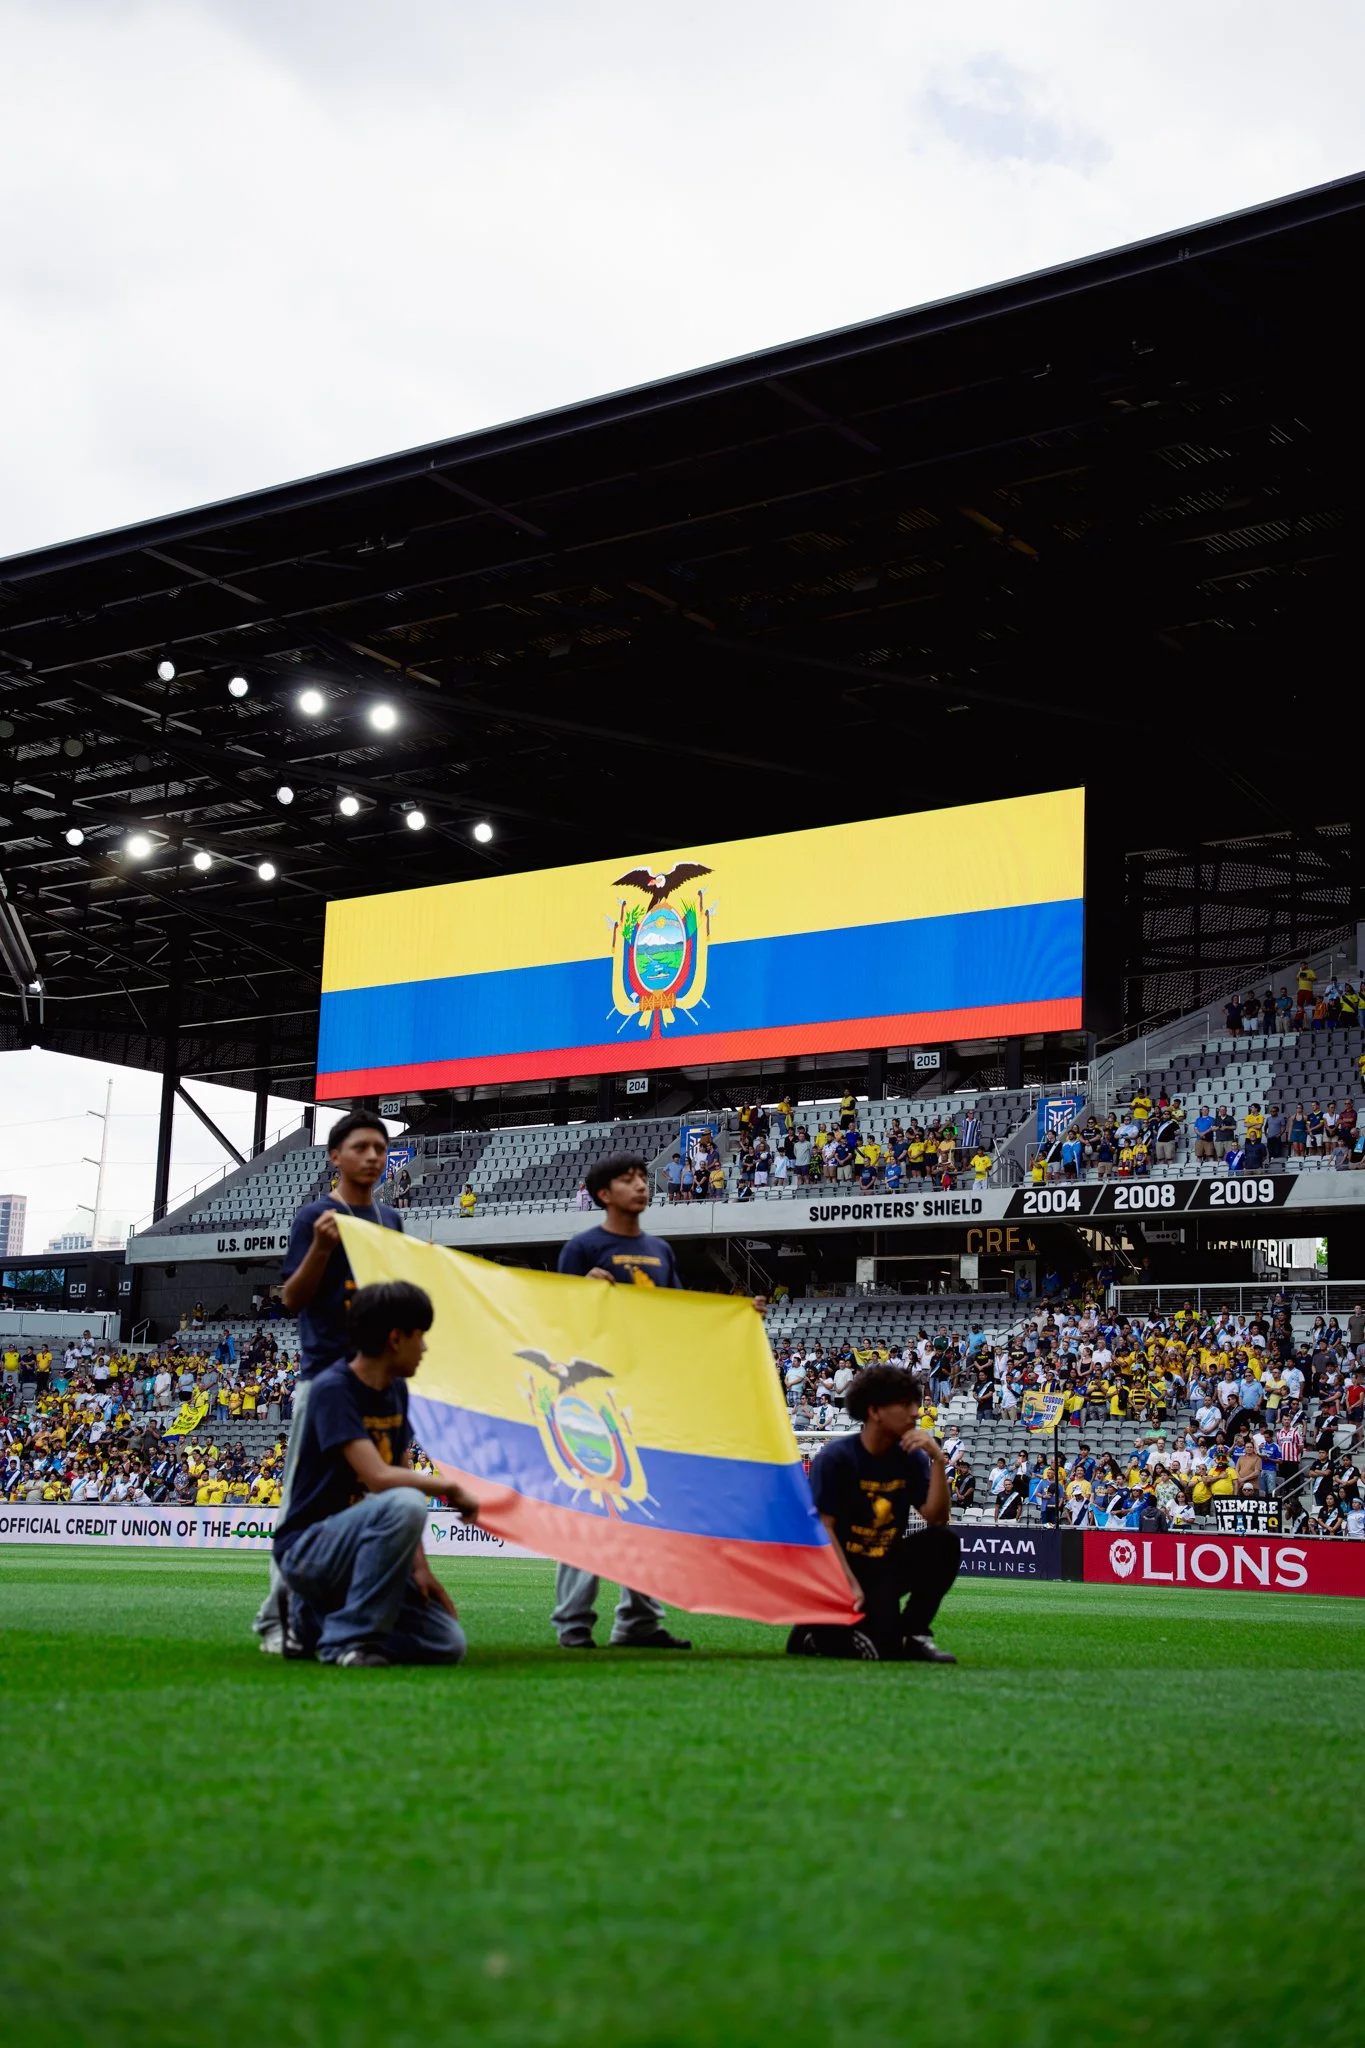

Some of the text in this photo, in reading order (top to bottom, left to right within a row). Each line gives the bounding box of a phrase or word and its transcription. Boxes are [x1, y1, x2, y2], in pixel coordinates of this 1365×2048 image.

[916, 1055, 937, 1067] 205
[628, 1081, 646, 1092] 204
[382, 1103, 399, 1114] 203
[1023, 1179, 1275, 1214] 2004 2008 2009
[922, 1198, 983, 1216] SHIELD
[217, 1238, 240, 1252] U.S.
[244, 1236, 275, 1251] OPEN
[1214, 1499, 1279, 1515] SIEMPRE
[0, 1517, 61, 1534] OFFICIAL
[66, 1518, 117, 1535] CREDIT
[122, 1519, 172, 1537] UNION
[176, 1520, 198, 1537] OF
[202, 1520, 231, 1538] THE
[959, 1537, 1036, 1556] LATAM
[959, 1560, 1037, 1573] AIRLINES
[1142, 1541, 1309, 1588] LIONS
